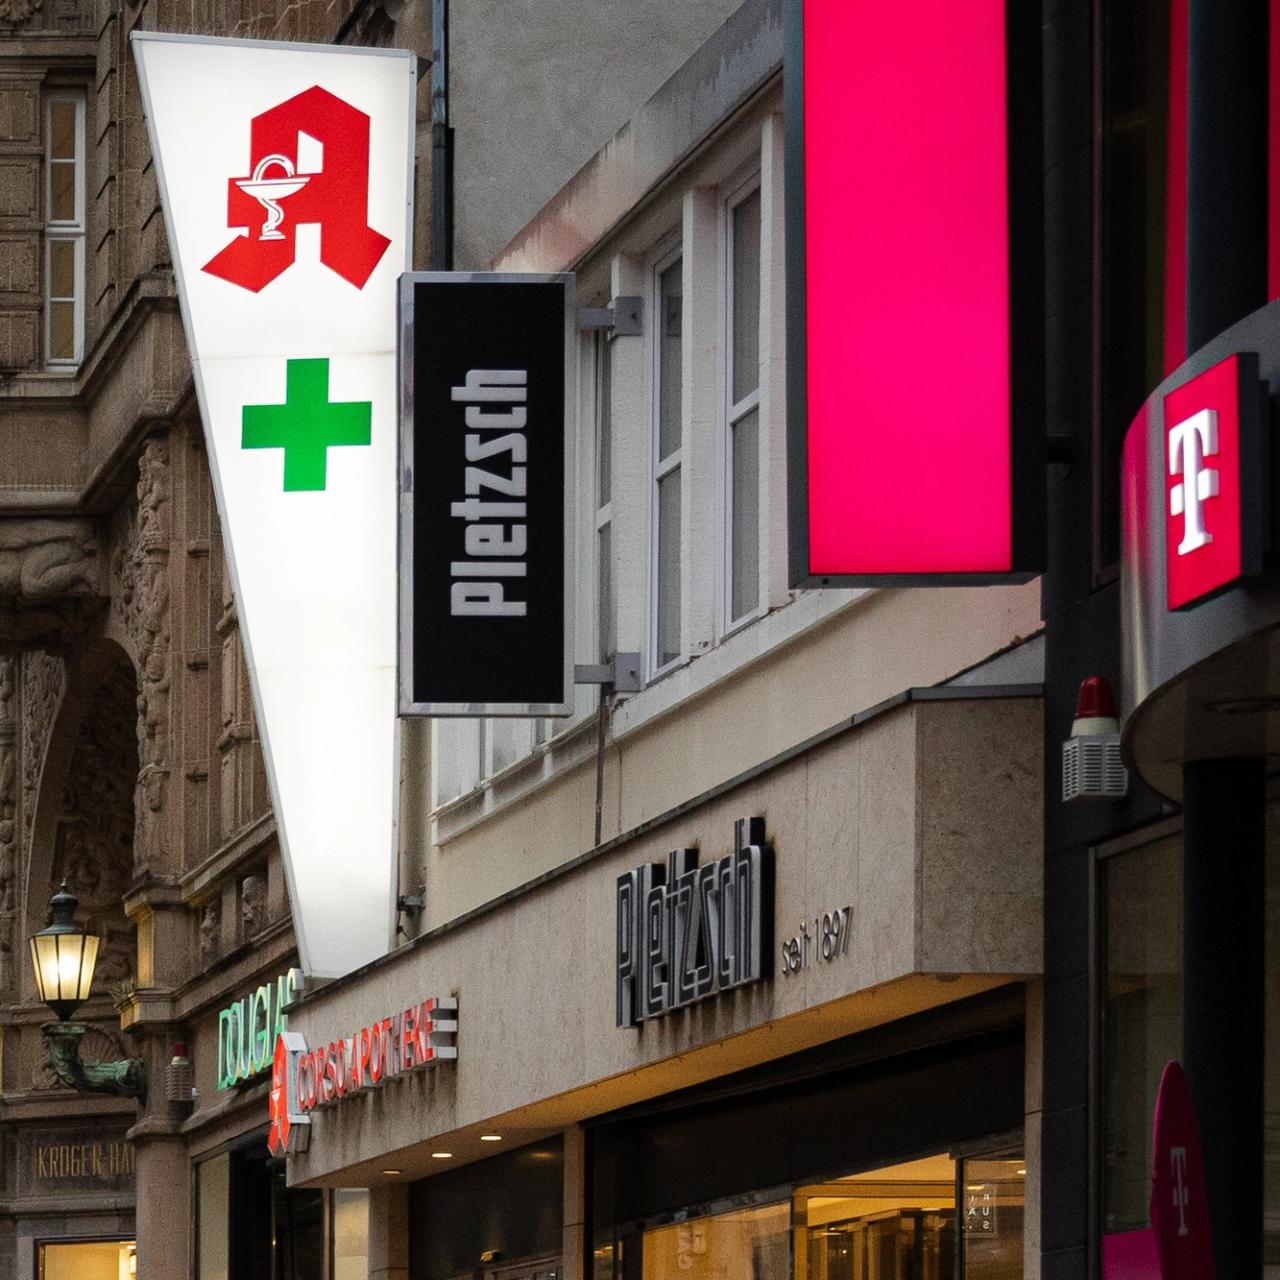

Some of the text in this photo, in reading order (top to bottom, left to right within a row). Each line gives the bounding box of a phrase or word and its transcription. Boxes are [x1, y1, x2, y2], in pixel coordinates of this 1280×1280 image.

[451, 369, 527, 616] Pletzsch
[616, 816, 853, 1028] Pletzsch seit 1897
[297, 1039, 347, 1111] CORSO
[351, 997, 442, 1089] APOTHEKE
